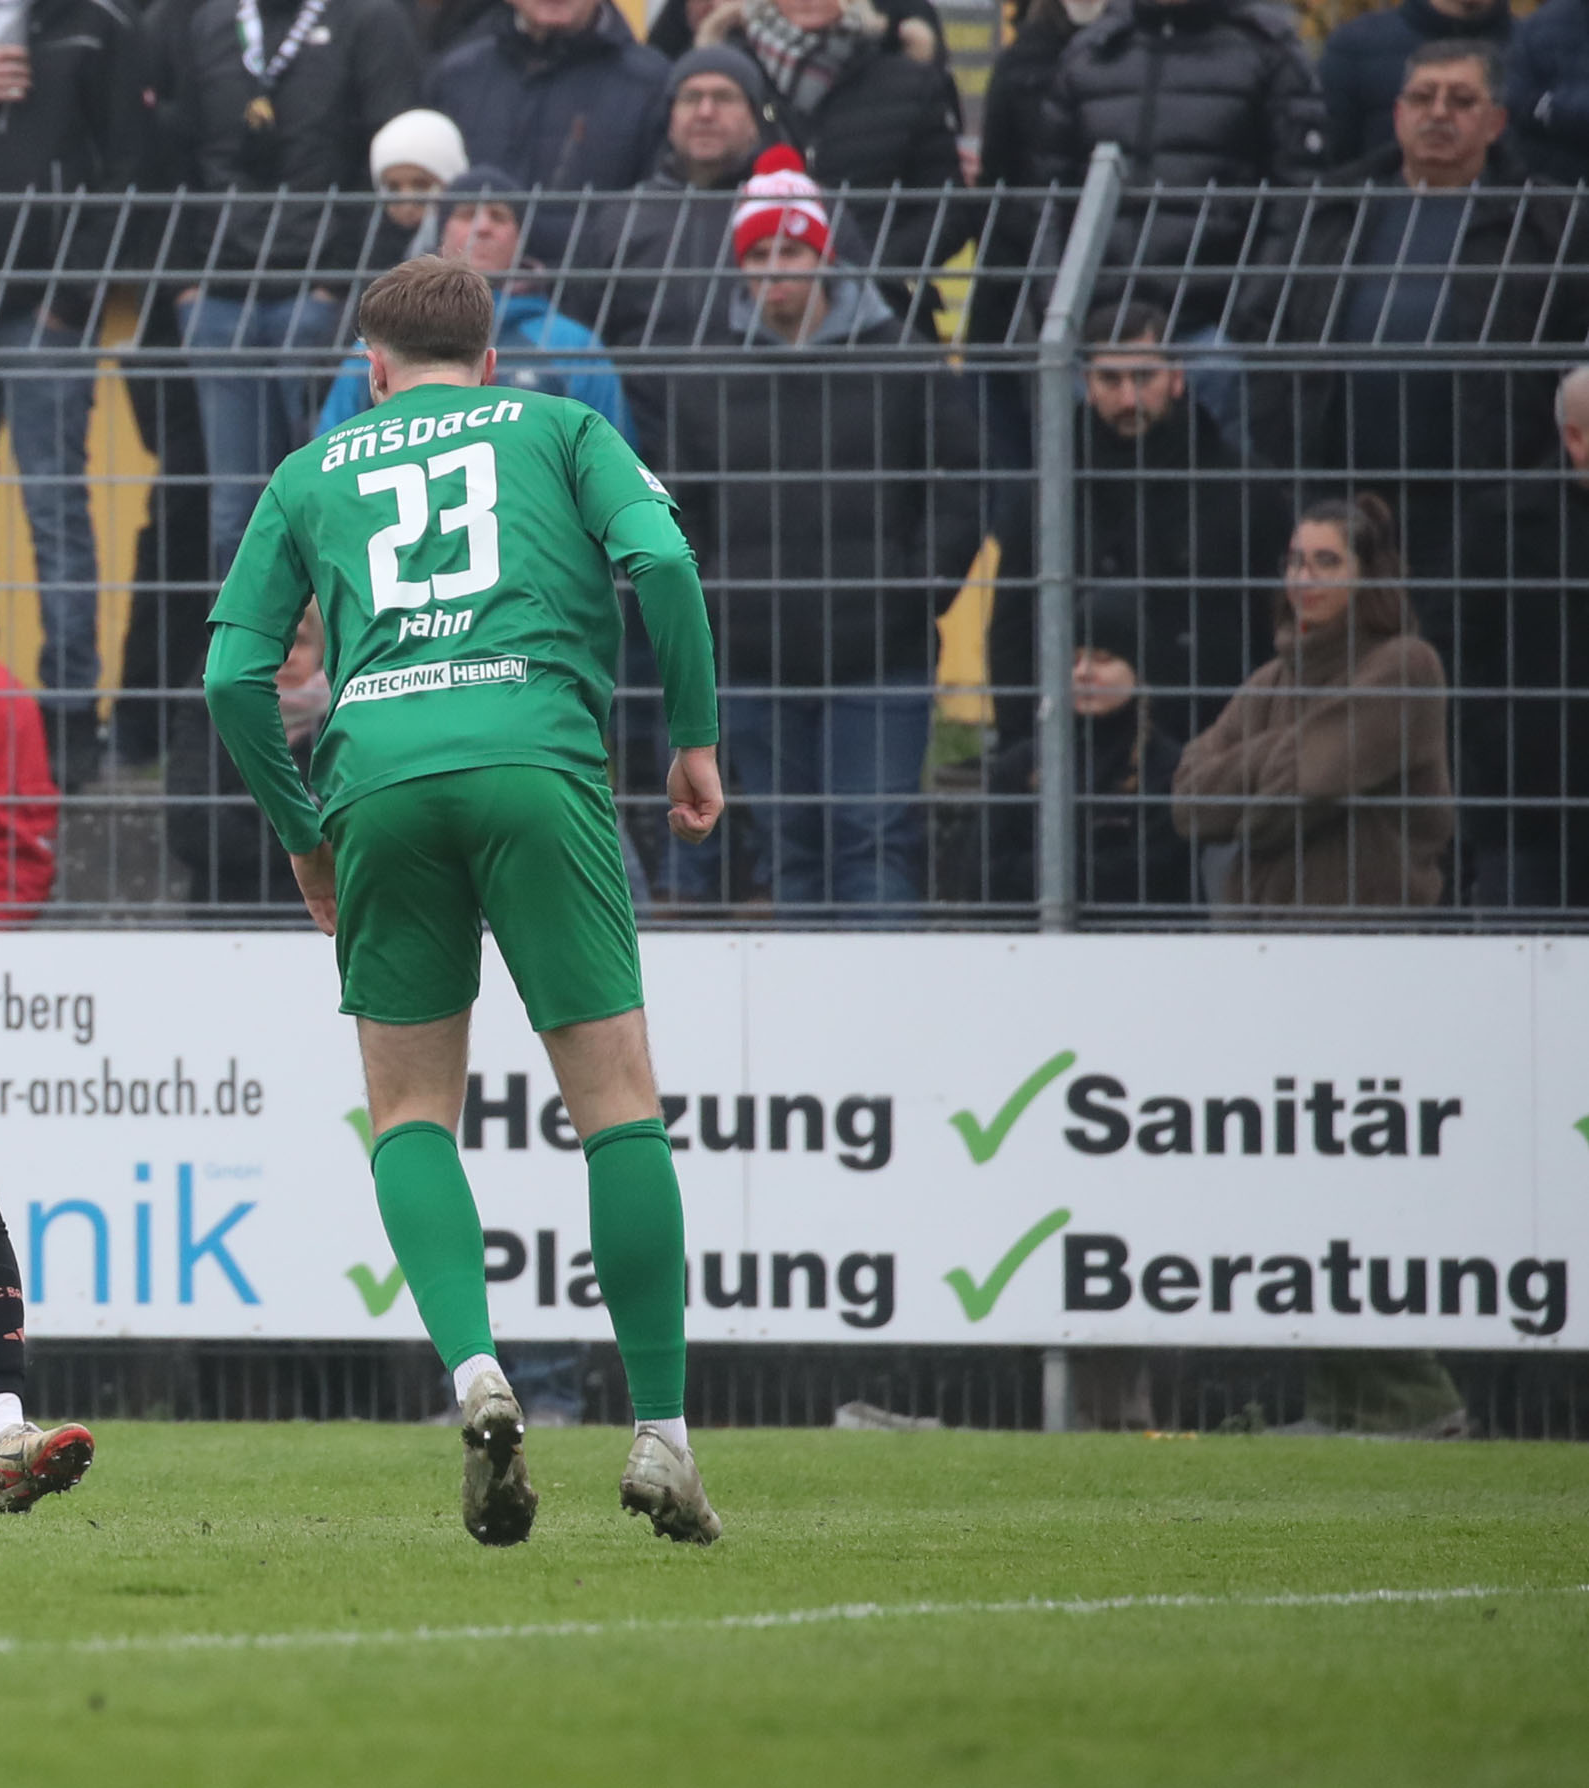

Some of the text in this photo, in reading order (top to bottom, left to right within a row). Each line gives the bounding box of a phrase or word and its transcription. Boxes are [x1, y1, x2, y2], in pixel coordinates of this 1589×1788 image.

[321, 400, 523, 473] ansbach
[357, 441, 501, 617] 23
[453, 659, 524, 683] HEINEN
[463, 1073, 895, 1171] Hezung
[1063, 1074, 1462, 1157] Sanitär
[483, 1229, 895, 1329] Plaung
[1062, 1233, 1569, 1336] Beratung
